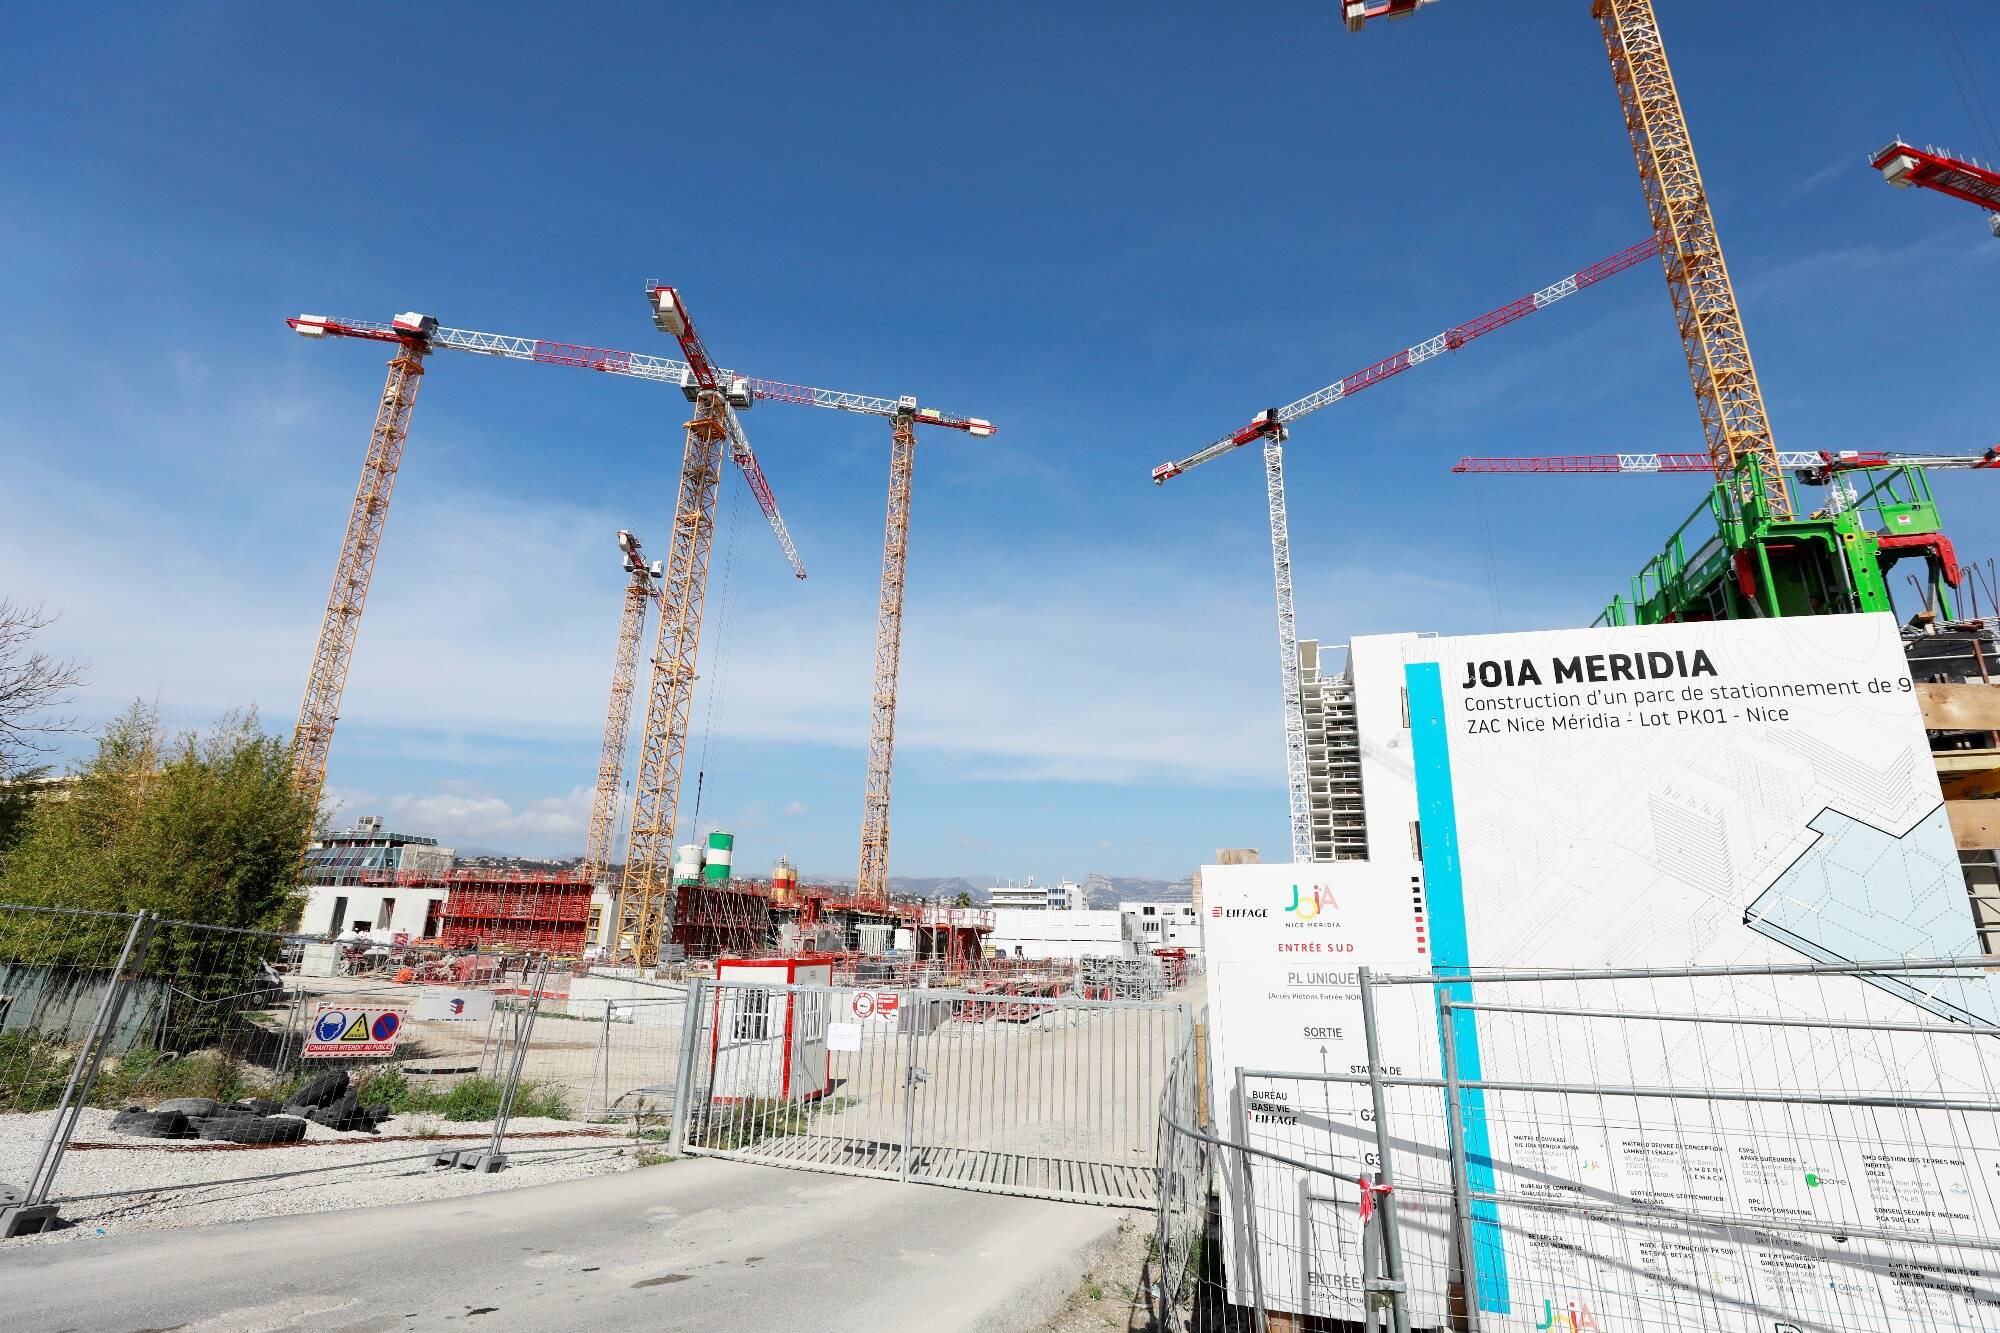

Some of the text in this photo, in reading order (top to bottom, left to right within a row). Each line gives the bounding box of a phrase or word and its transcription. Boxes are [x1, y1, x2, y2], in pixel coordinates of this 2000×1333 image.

[1463, 649, 1718, 689] JOIA MERIDIA
[1465, 677, 1912, 711] Construction d'un parc de stationnement de 9
[1467, 718, 1501, 734] ZAC
[1507, 717, 1545, 732] Nice
[1552, 713, 1620, 731] Méridia
[1640, 711, 1671, 727] Lot
[1677, 708, 1728, 725] PK01
[1746, 706, 1789, 723] Nice
[1226, 908, 1268, 918] EIFFAGE
[1278, 941, 1354, 952] ENTRÉE SUD
[1288, 972, 1303, 984] PL
[1304, 1026, 1343, 1038] SORTIE
[1350, 1065, 1402, 1075] STATN DE
[1252, 1090, 1288, 1100] BUREAU
[1251, 1103, 1274, 1112] BASE
[1255, 1115, 1299, 1126] EIFFAGE
[1308, 1272, 1360, 1289] ENTRÉE
